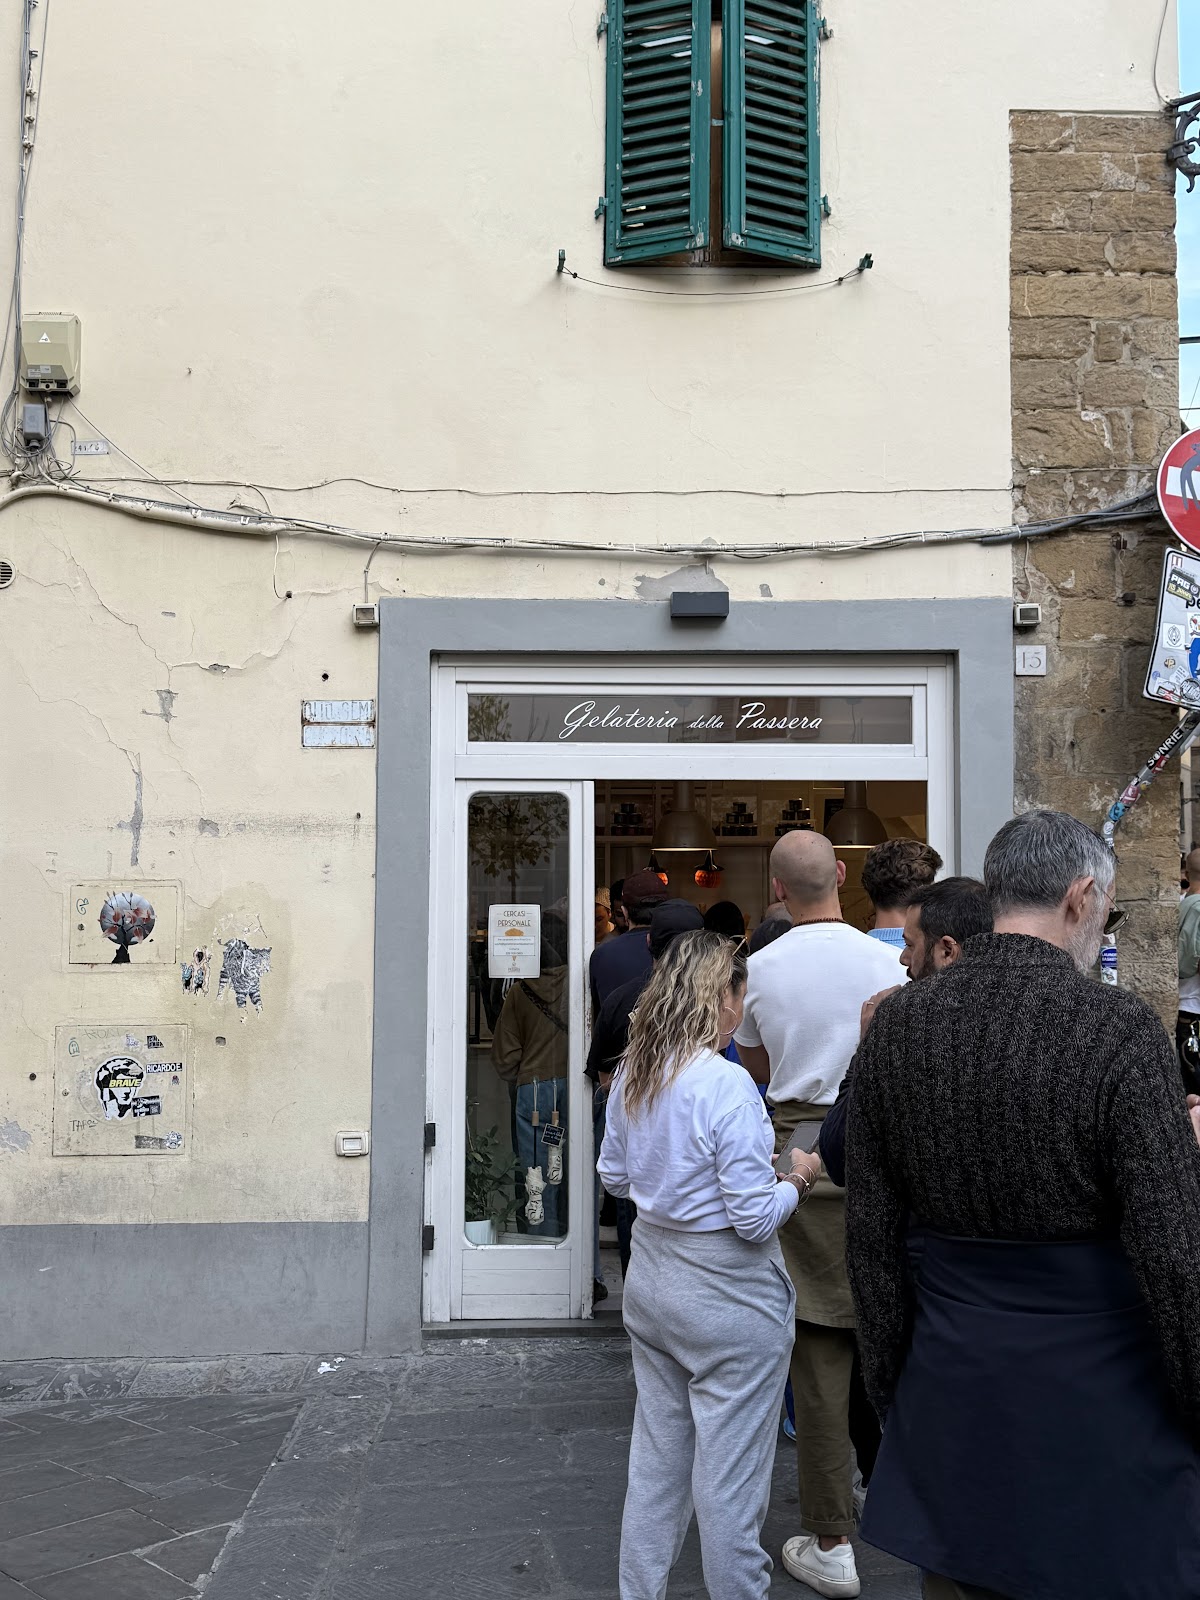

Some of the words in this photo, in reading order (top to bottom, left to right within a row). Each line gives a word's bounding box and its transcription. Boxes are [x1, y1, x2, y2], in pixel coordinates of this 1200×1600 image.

[1022, 651, 1042, 669] 15
[558, 700, 678, 739] Gelateria
[687, 714, 725, 729] della
[735, 702, 823, 729] Passera
[497, 919, 531, 927] PERSONALE
[146, 1063, 175, 1073] RICARDO
[109, 1078, 142, 1088] BRAVE
